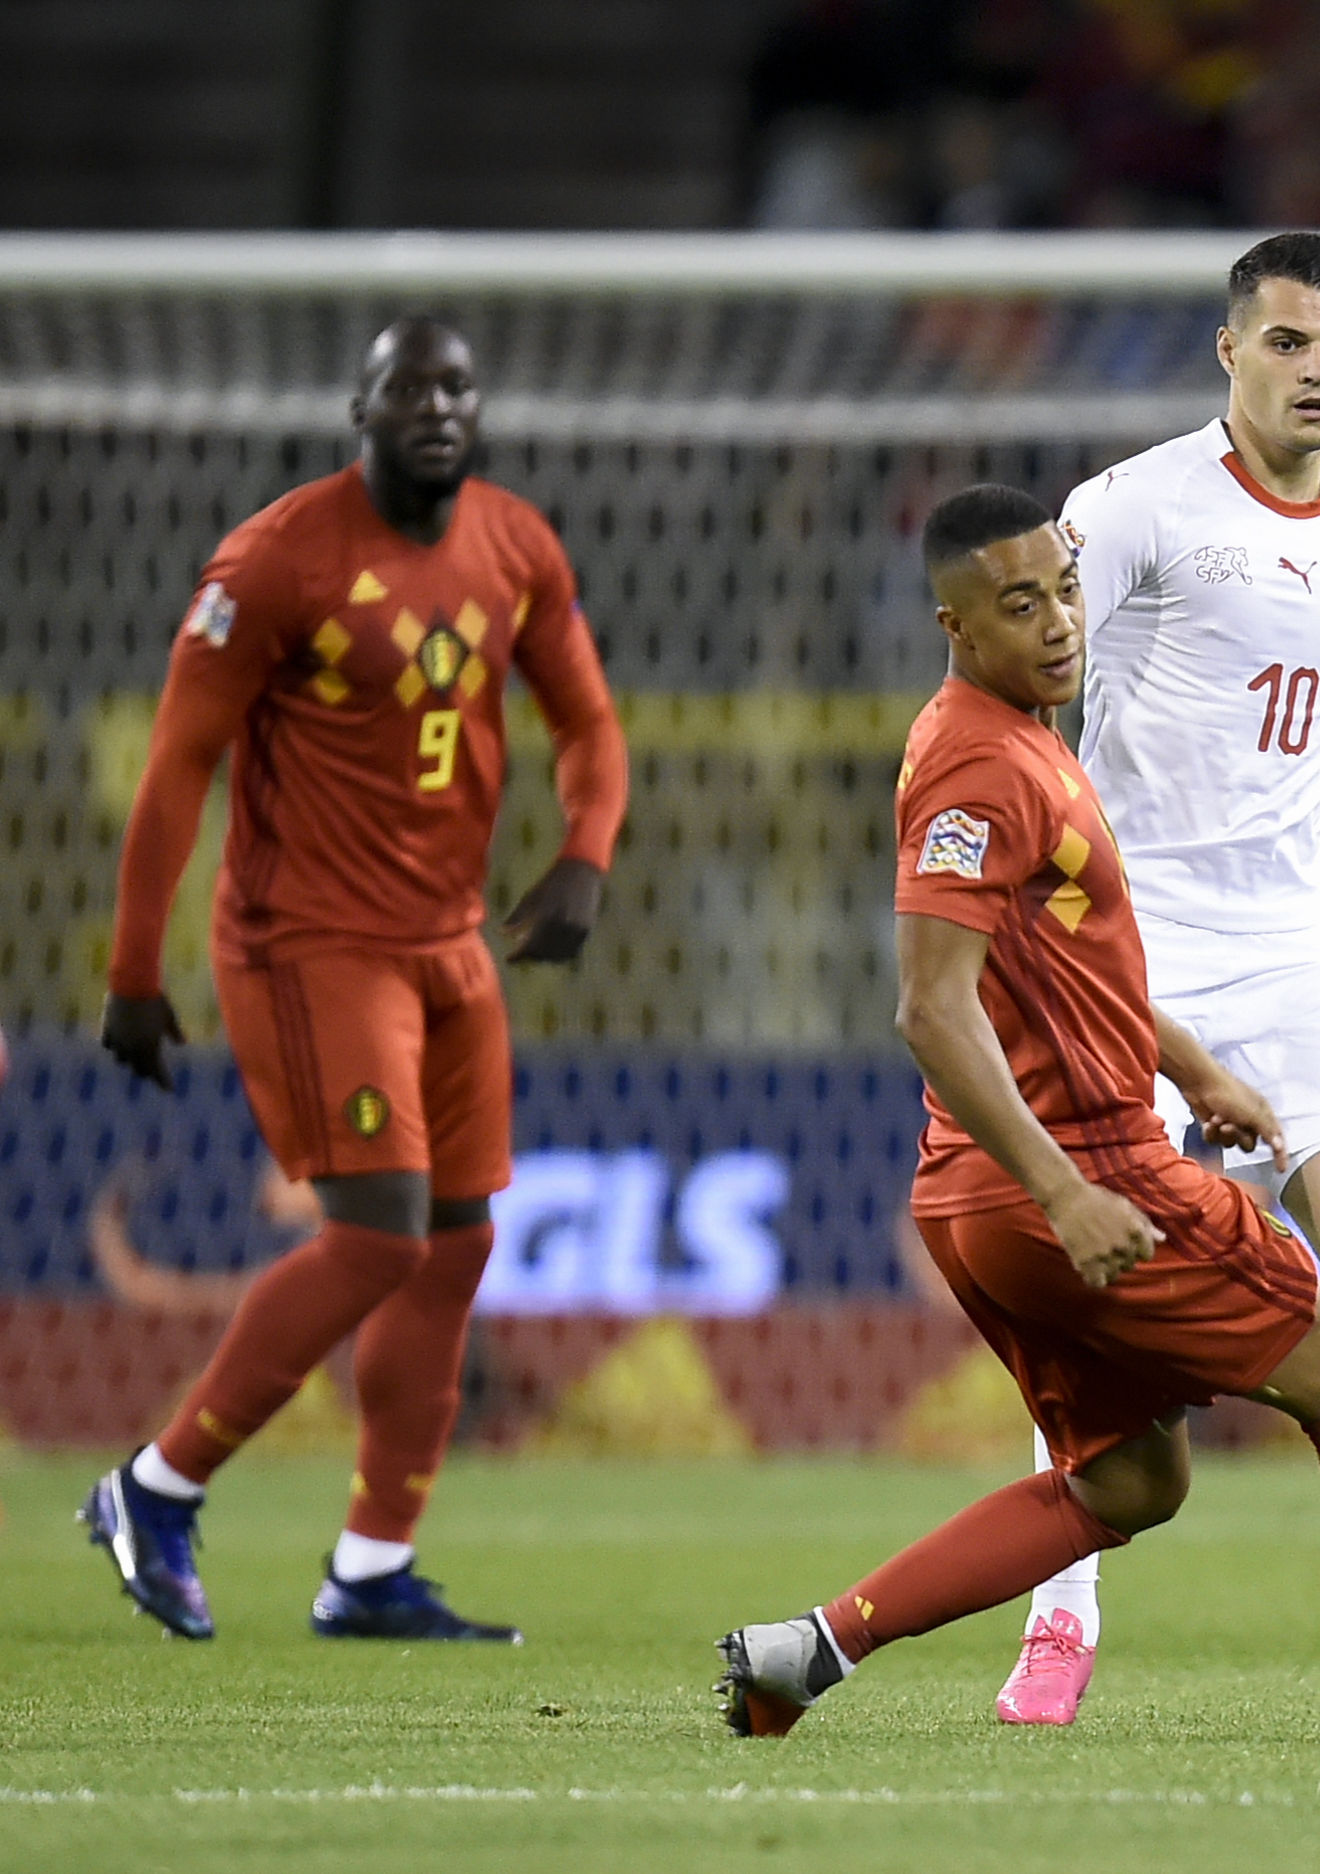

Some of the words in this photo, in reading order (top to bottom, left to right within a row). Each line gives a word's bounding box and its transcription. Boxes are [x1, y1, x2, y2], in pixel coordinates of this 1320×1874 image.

[419, 709, 460, 790] 9
[1247, 663, 1319, 756] 10
[474, 1148, 790, 1320] GLS
